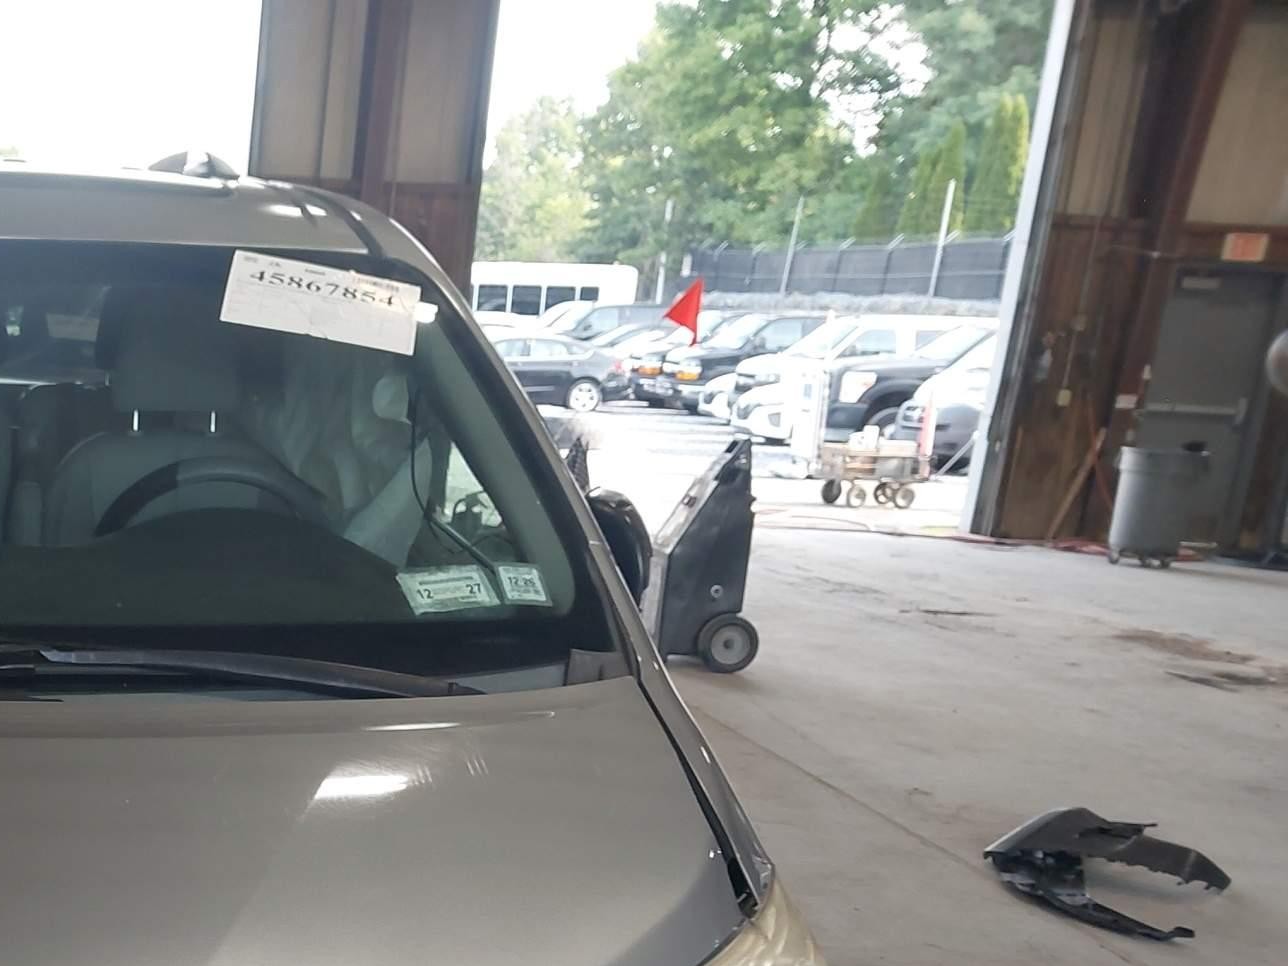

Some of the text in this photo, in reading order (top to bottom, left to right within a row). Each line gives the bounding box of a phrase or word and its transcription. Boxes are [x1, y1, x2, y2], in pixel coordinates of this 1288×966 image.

[249, 270, 394, 306] 45867854
[416, 583, 481, 600] 12 27
